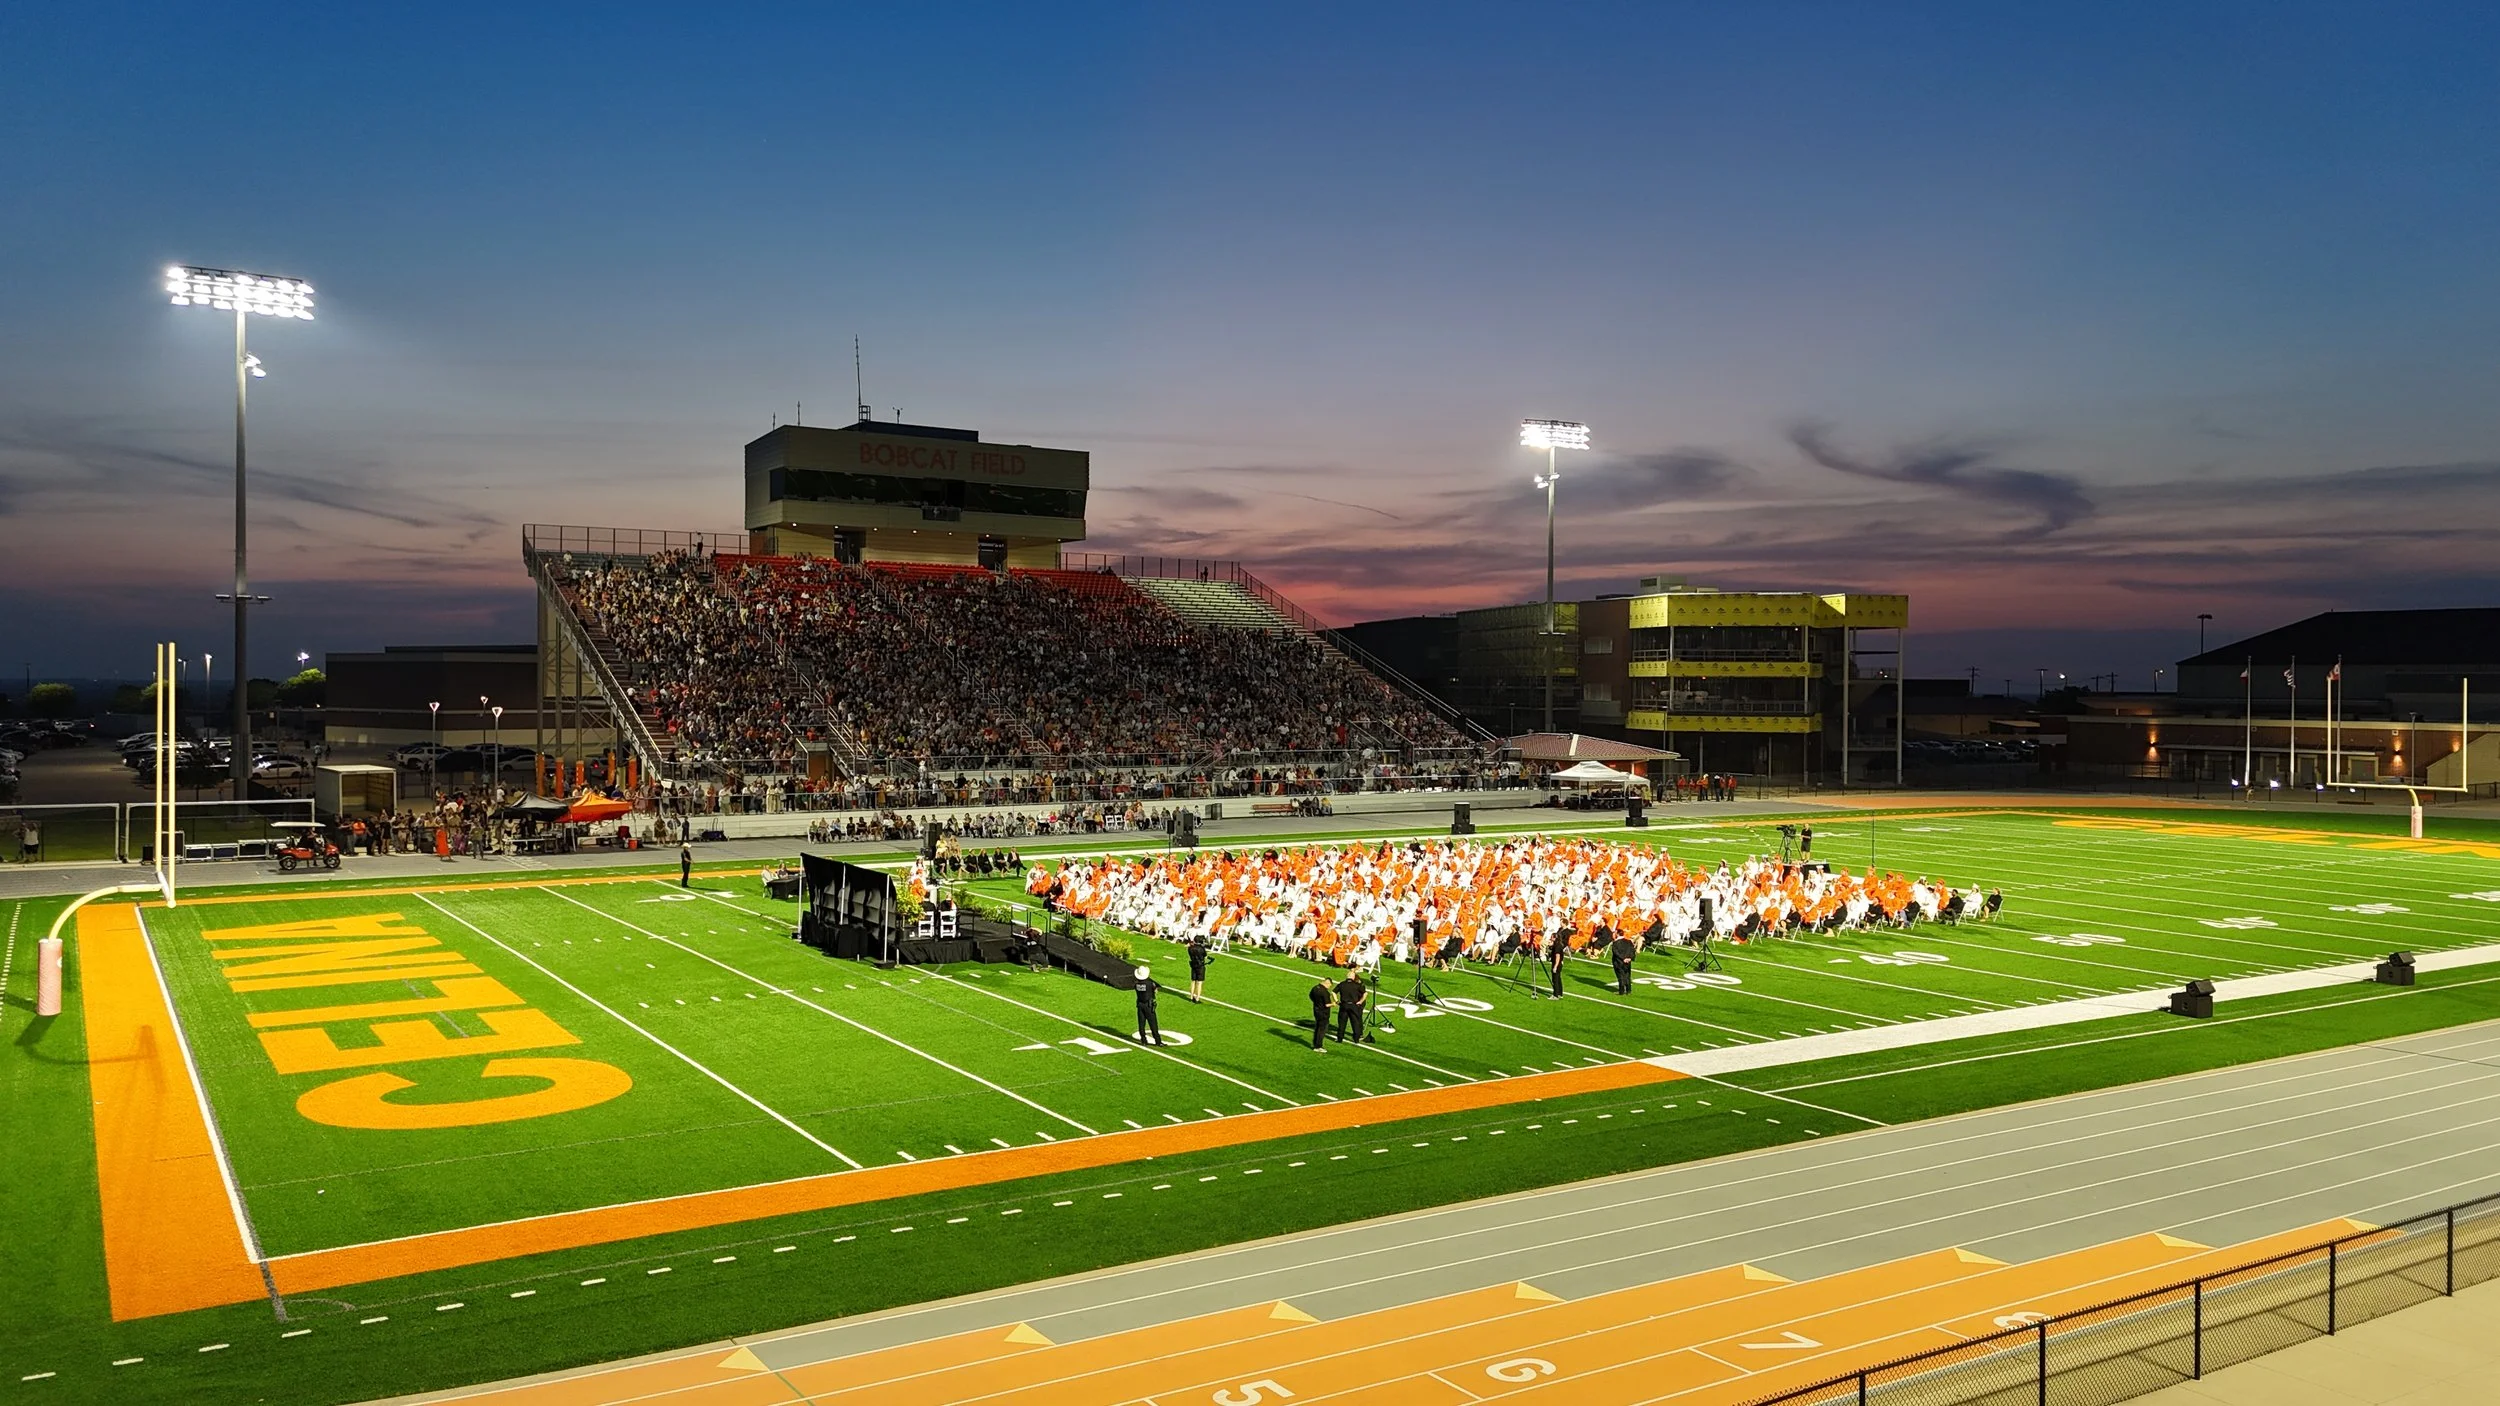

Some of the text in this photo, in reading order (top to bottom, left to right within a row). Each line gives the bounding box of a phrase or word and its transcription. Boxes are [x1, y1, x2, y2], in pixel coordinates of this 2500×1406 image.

[860, 442, 1026, 475] BOBCAT FIELD
[2030, 933, 2126, 947] 50
[1859, 951, 1950, 966] 40
[1632, 972, 1743, 991] 30
[201, 912, 633, 1129] CELINA
[1058, 1029, 1193, 1056] 10
[1738, 1331, 1824, 1350] 7
[1212, 1379, 1296, 1406] 5
